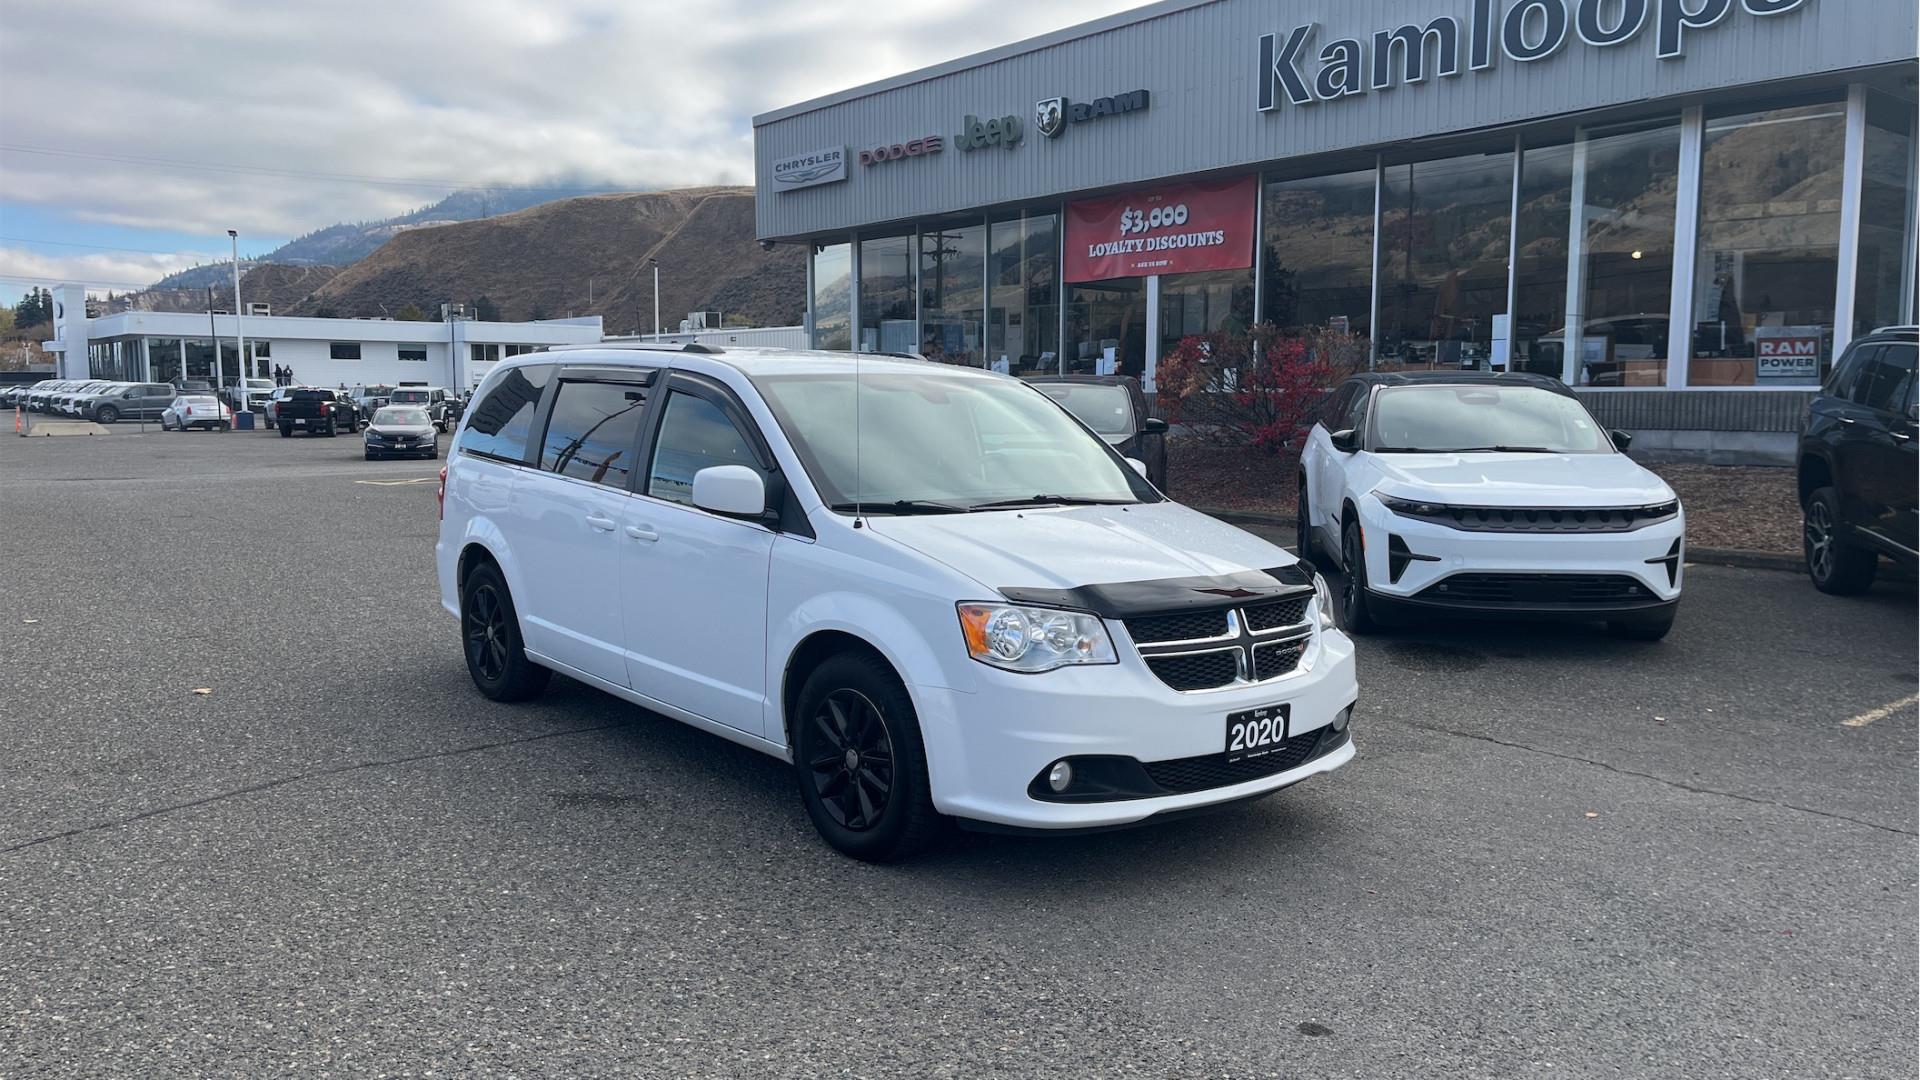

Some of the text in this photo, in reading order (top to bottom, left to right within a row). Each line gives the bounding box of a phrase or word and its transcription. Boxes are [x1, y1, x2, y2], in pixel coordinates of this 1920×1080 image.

[1257, 0, 1807, 112] Kamloop
[1069, 89, 1149, 123] RAM
[954, 115, 1024, 151] Jeep
[775, 151, 841, 172] CHRYSLER
[859, 136, 943, 166] DODGE
[1120, 204, 1188, 236] $3,000
[1088, 230, 1224, 257] LOYALTY DISCOUNTS
[1760, 341, 1815, 354] RAM
[1761, 358, 1814, 367] POWER
[1230, 716, 1284, 751] 2020
